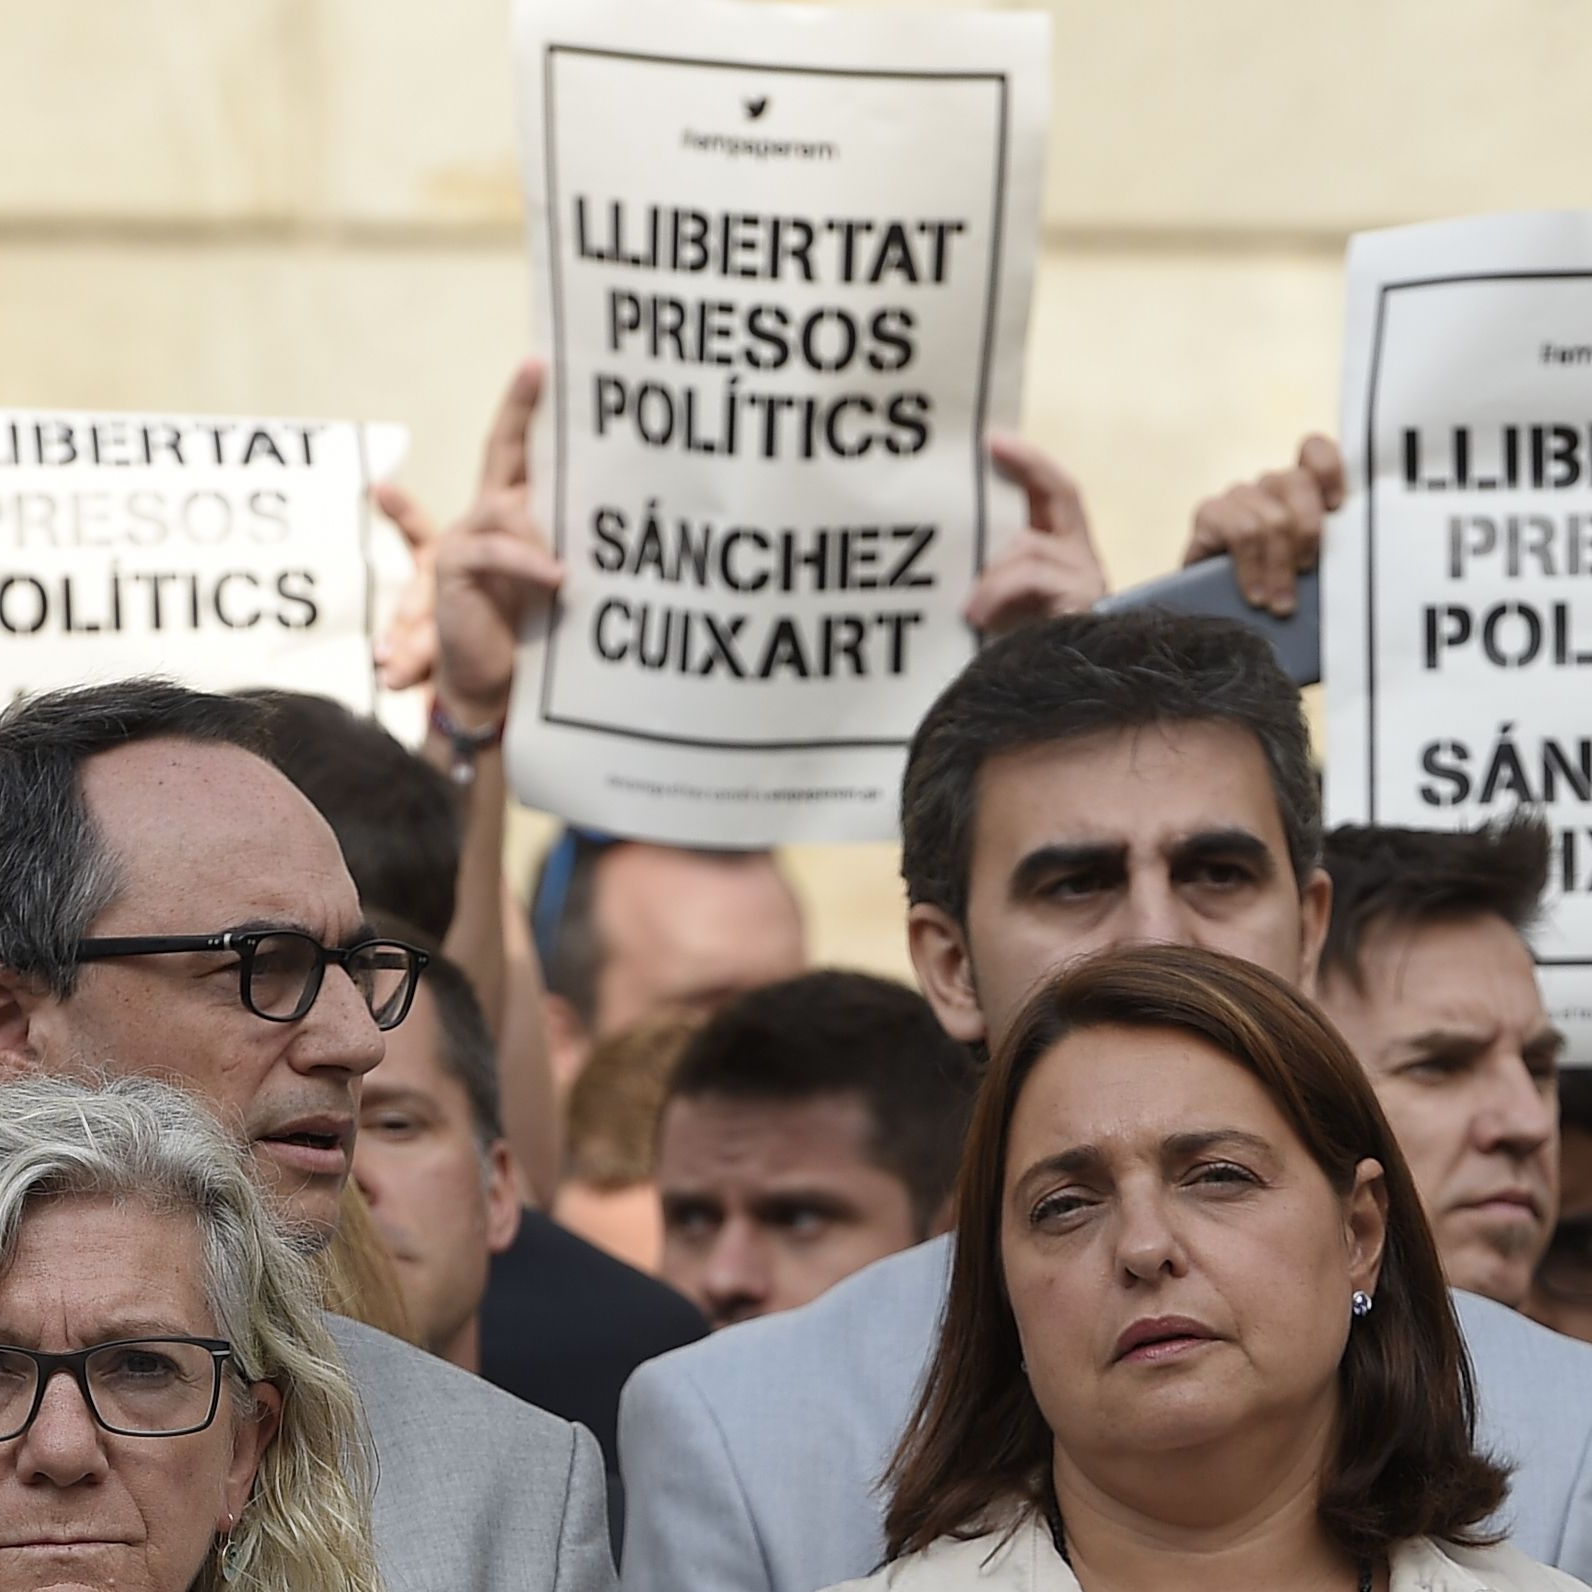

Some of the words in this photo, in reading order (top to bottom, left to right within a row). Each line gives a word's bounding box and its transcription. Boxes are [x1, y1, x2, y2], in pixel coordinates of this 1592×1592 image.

[574, 196, 967, 286] LLIBERTAT
[609, 289, 917, 374] PRESOS
[594, 375, 935, 461] POLÍTICS
[592, 500, 938, 594] SÁNCHEZ
[594, 600, 924, 681] CUIXART
